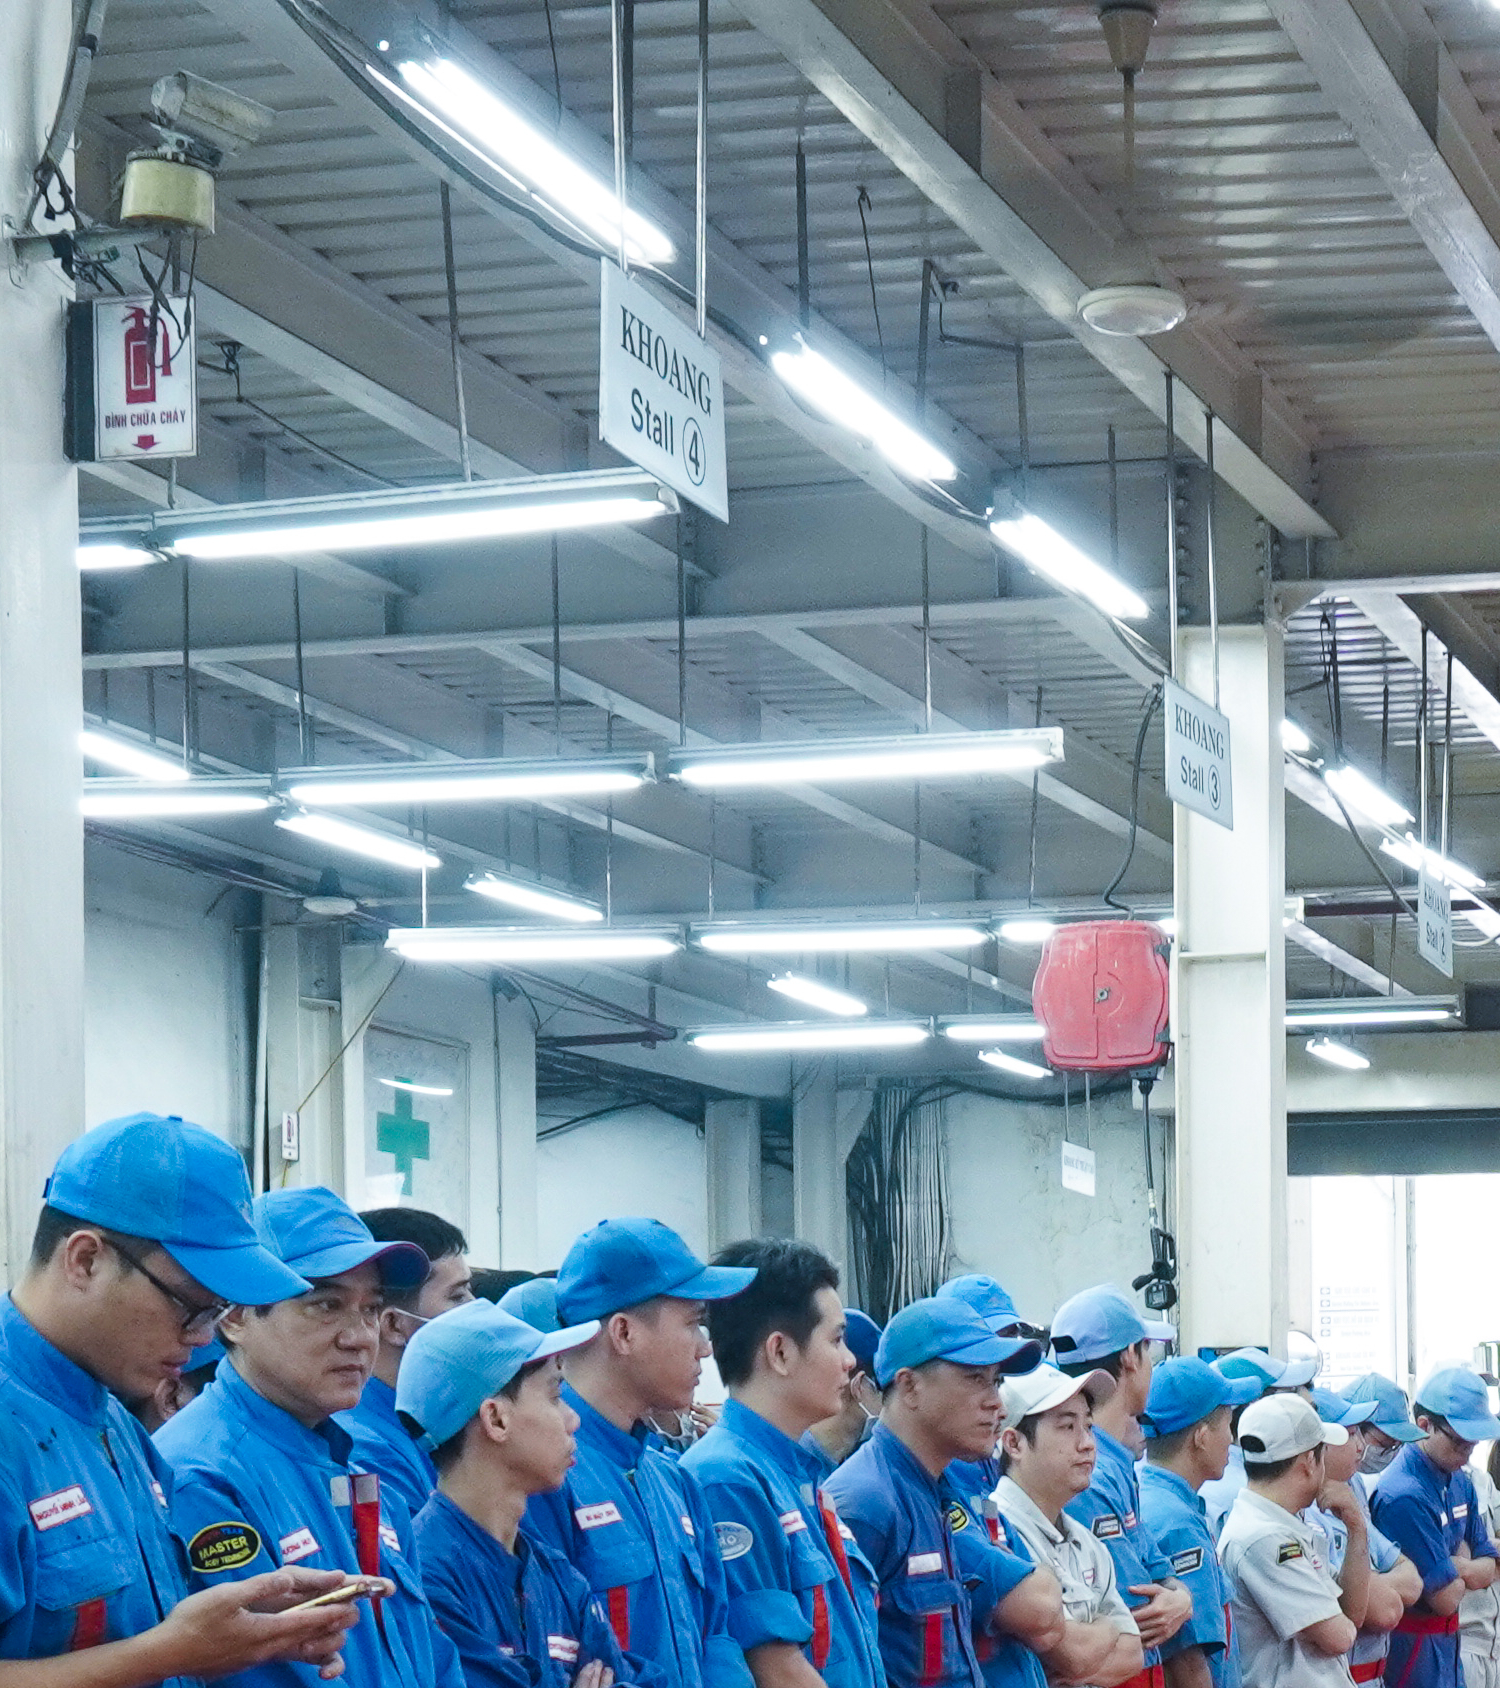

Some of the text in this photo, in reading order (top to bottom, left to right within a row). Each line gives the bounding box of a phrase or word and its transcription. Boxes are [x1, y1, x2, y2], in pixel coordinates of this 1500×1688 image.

[621, 304, 711, 418] KHOANG
[631, 387, 675, 456] Stall
[1175, 702, 1224, 760] KHOANG
[1180, 755, 1204, 794] Stall
[198, 1535, 249, 1561] MASTER
